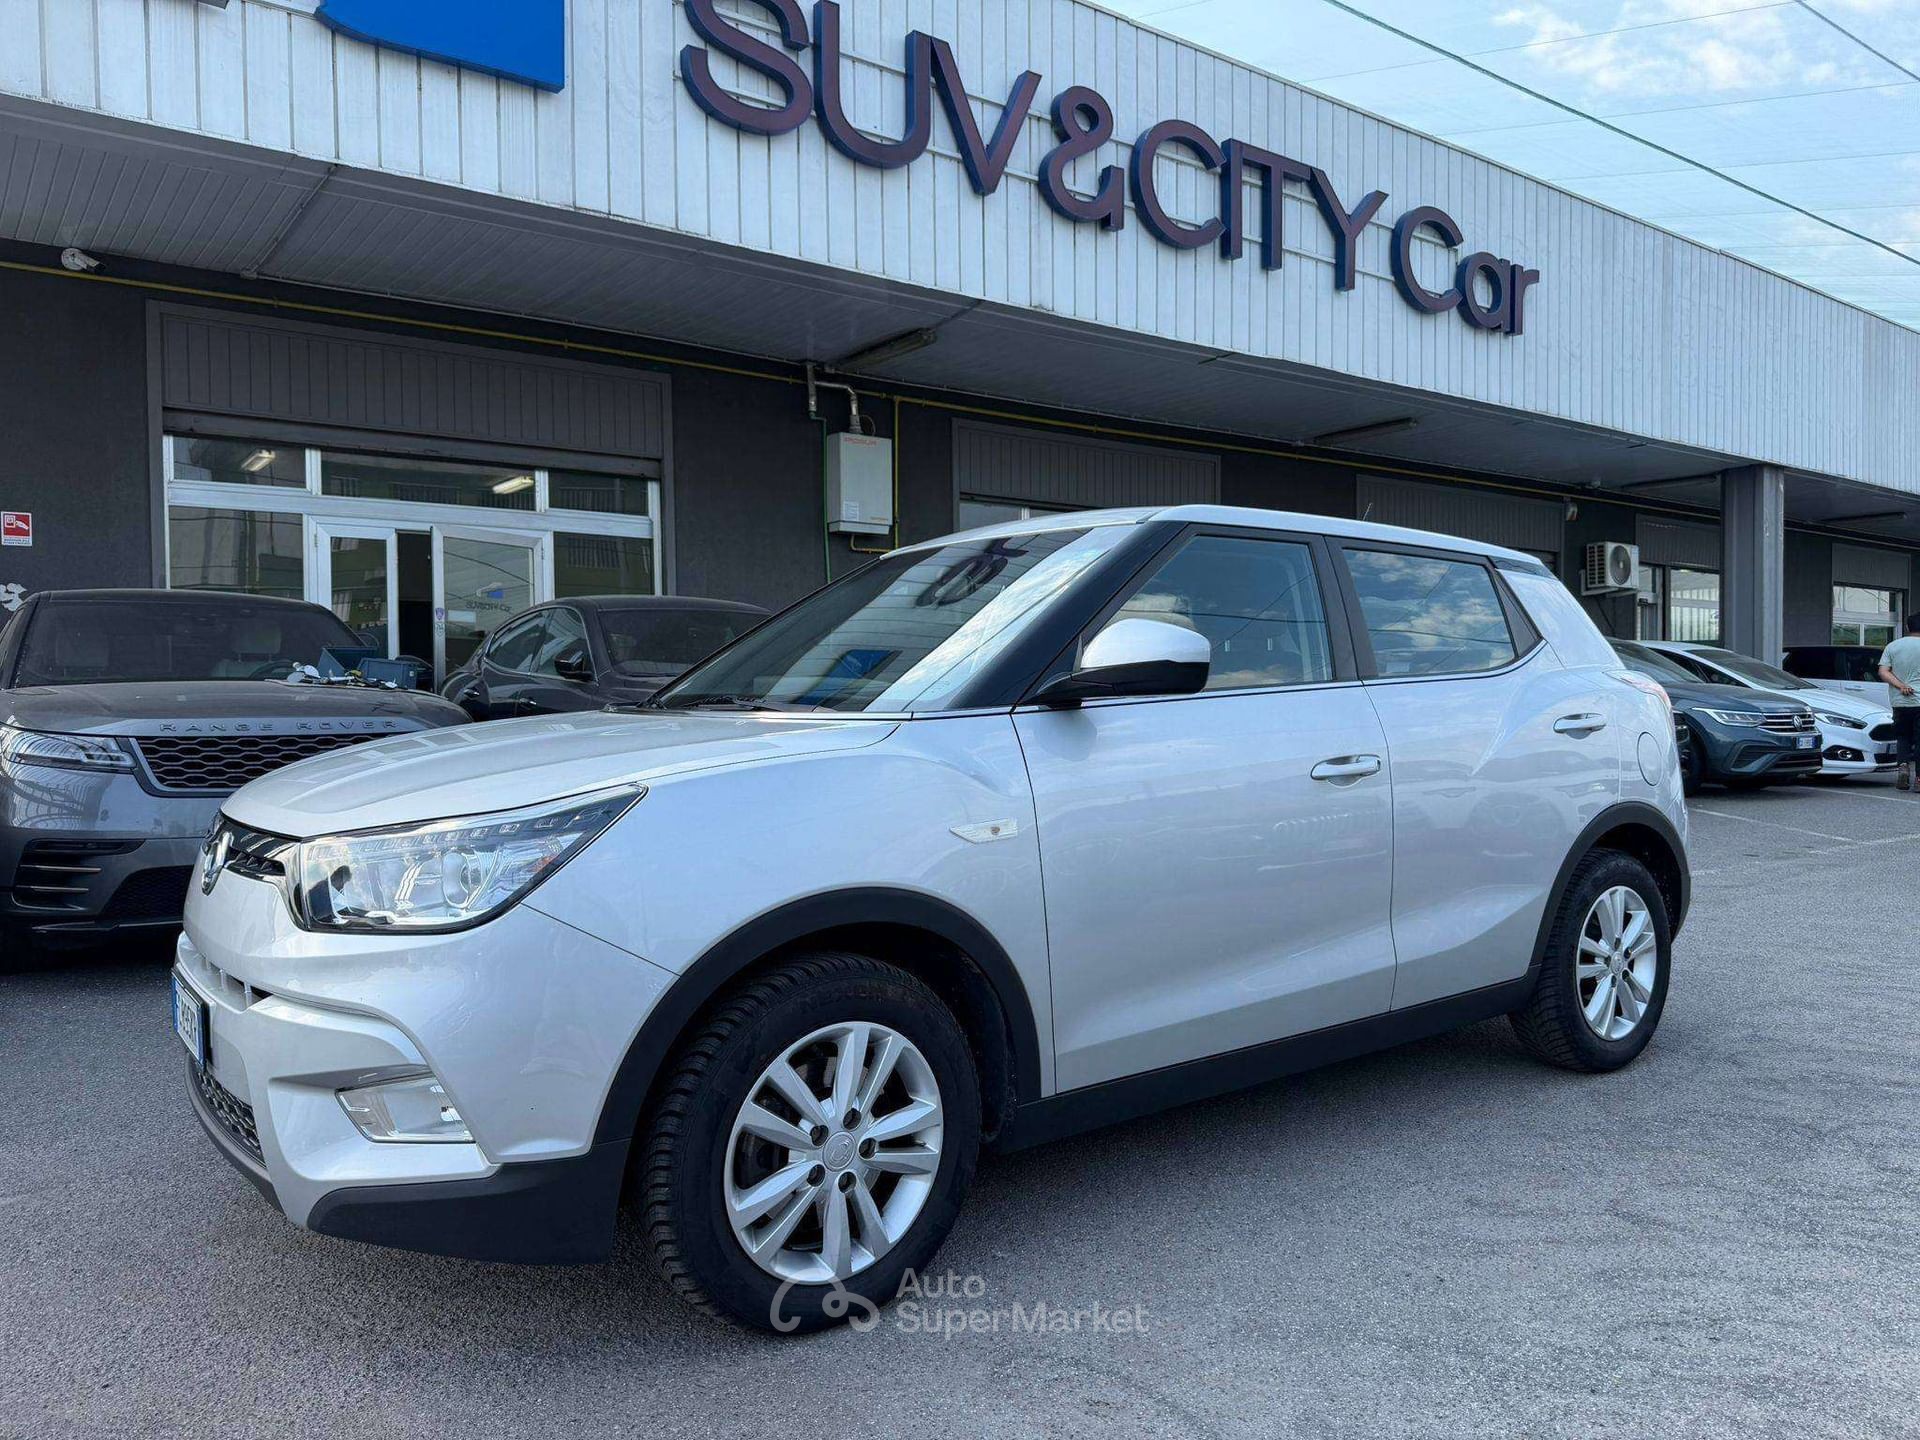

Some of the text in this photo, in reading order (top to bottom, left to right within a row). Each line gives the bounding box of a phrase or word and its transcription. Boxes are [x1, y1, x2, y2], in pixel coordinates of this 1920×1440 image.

[680, 0, 1540, 336] SUV&CITY Car
[159, 720, 398, 732] RANGE ROVER
